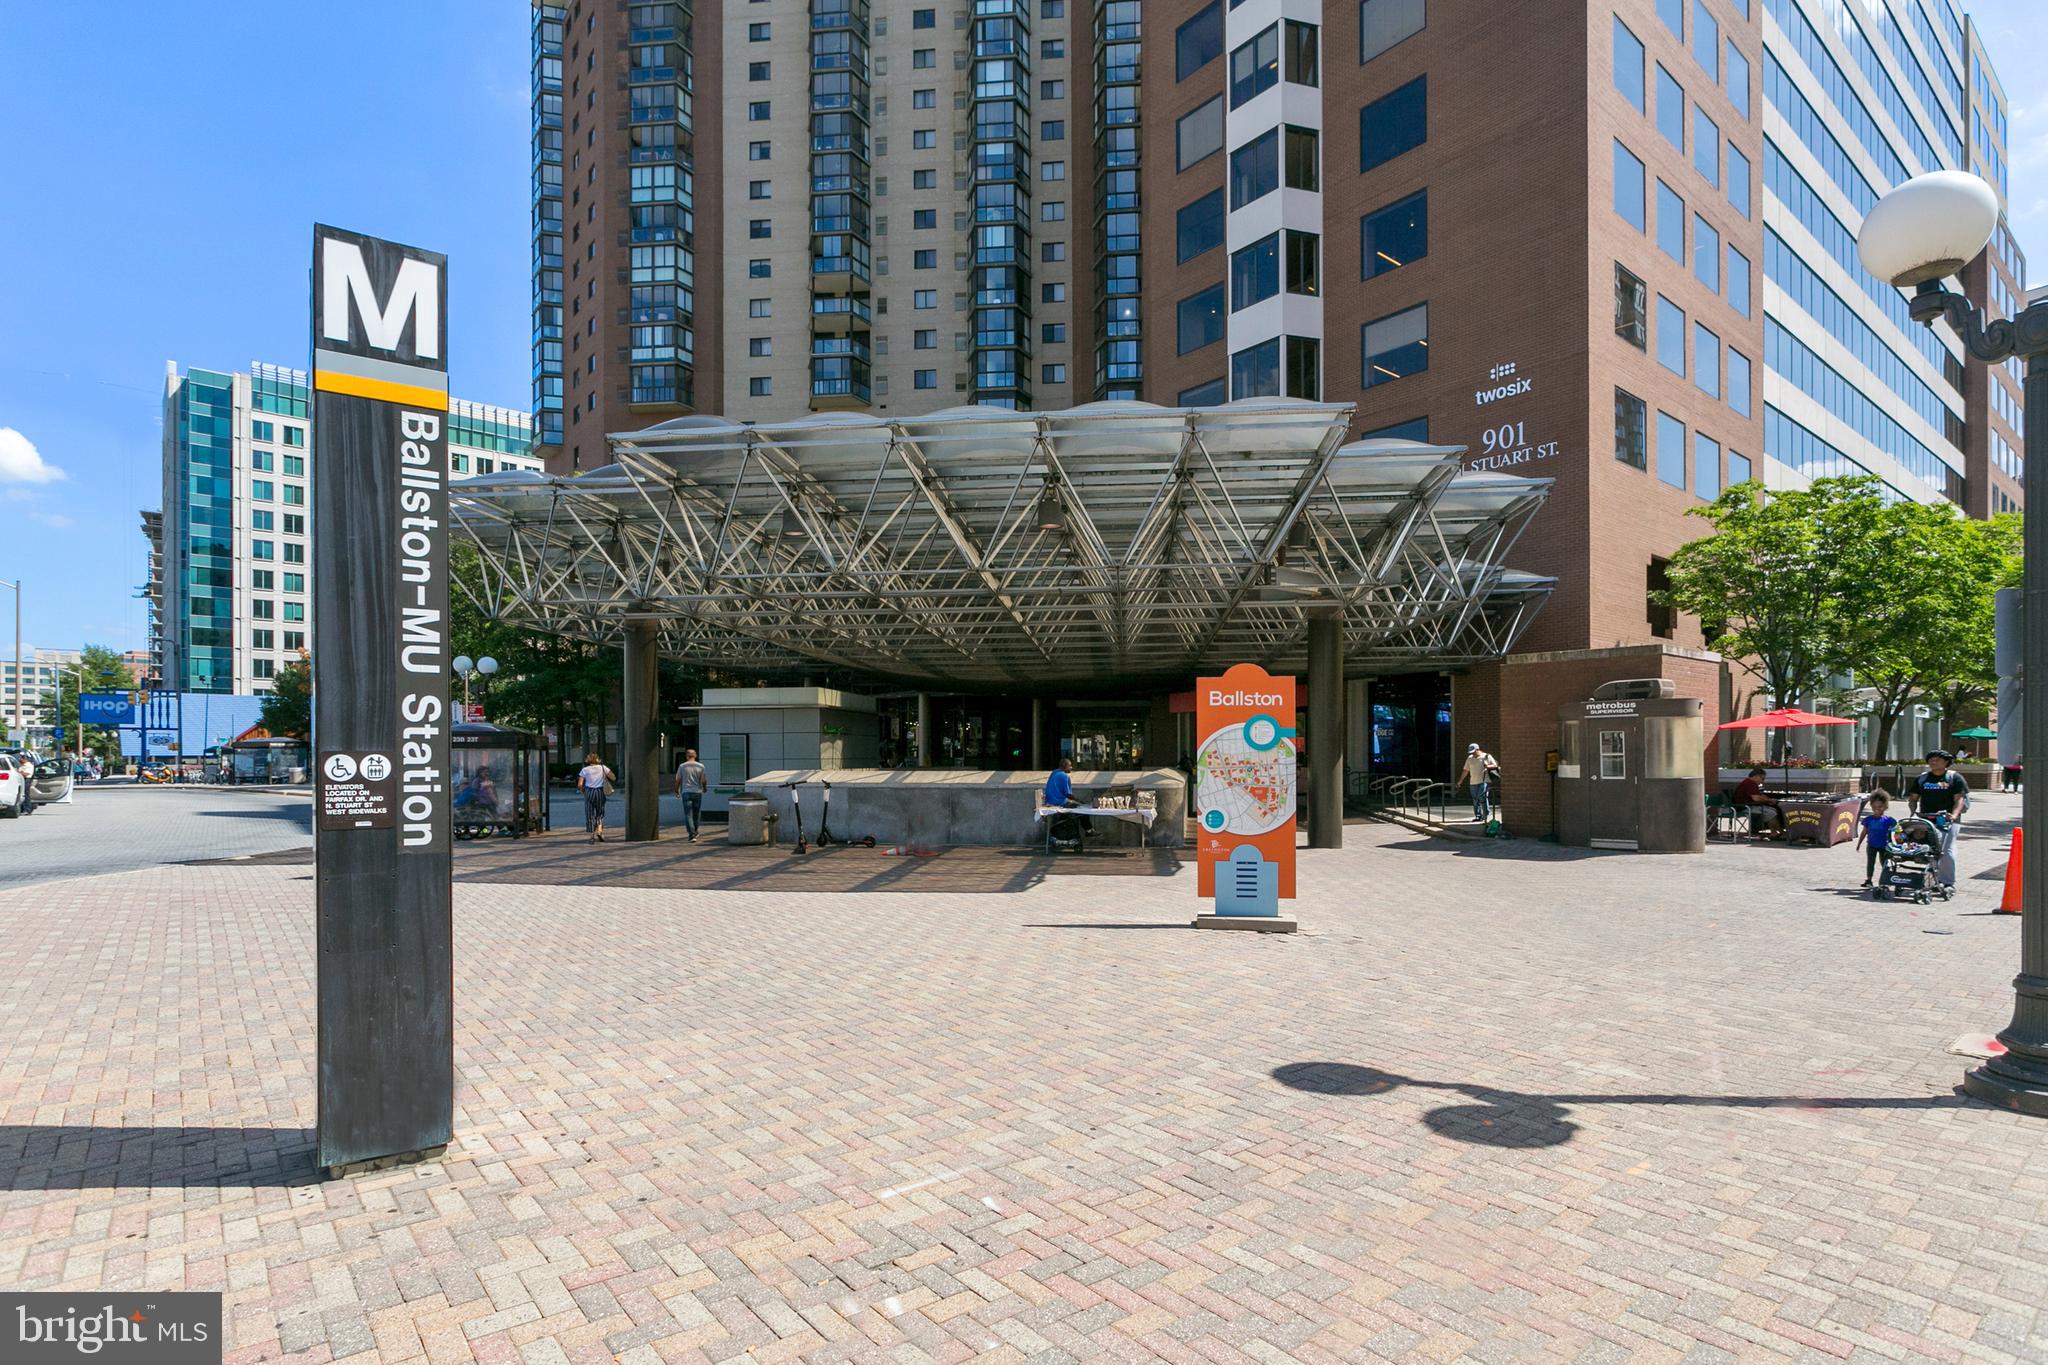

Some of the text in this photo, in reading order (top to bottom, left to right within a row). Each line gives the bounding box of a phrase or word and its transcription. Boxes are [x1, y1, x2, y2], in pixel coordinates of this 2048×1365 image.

[323, 237, 438, 360] M
[1475, 378, 1532, 405] twosix
[1482, 421, 1527, 454] 901
[1471, 447, 1533, 472] STUART
[1537, 442, 1560, 459] ST.
[400, 410, 442, 847] Ballston-MU Station
[1209, 690, 1283, 706] Ballston
[1586, 701, 1636, 710] metrobus
[1788, 817, 1820, 825] AND GIFTS
[1800, 810, 1822, 819] RINGS
